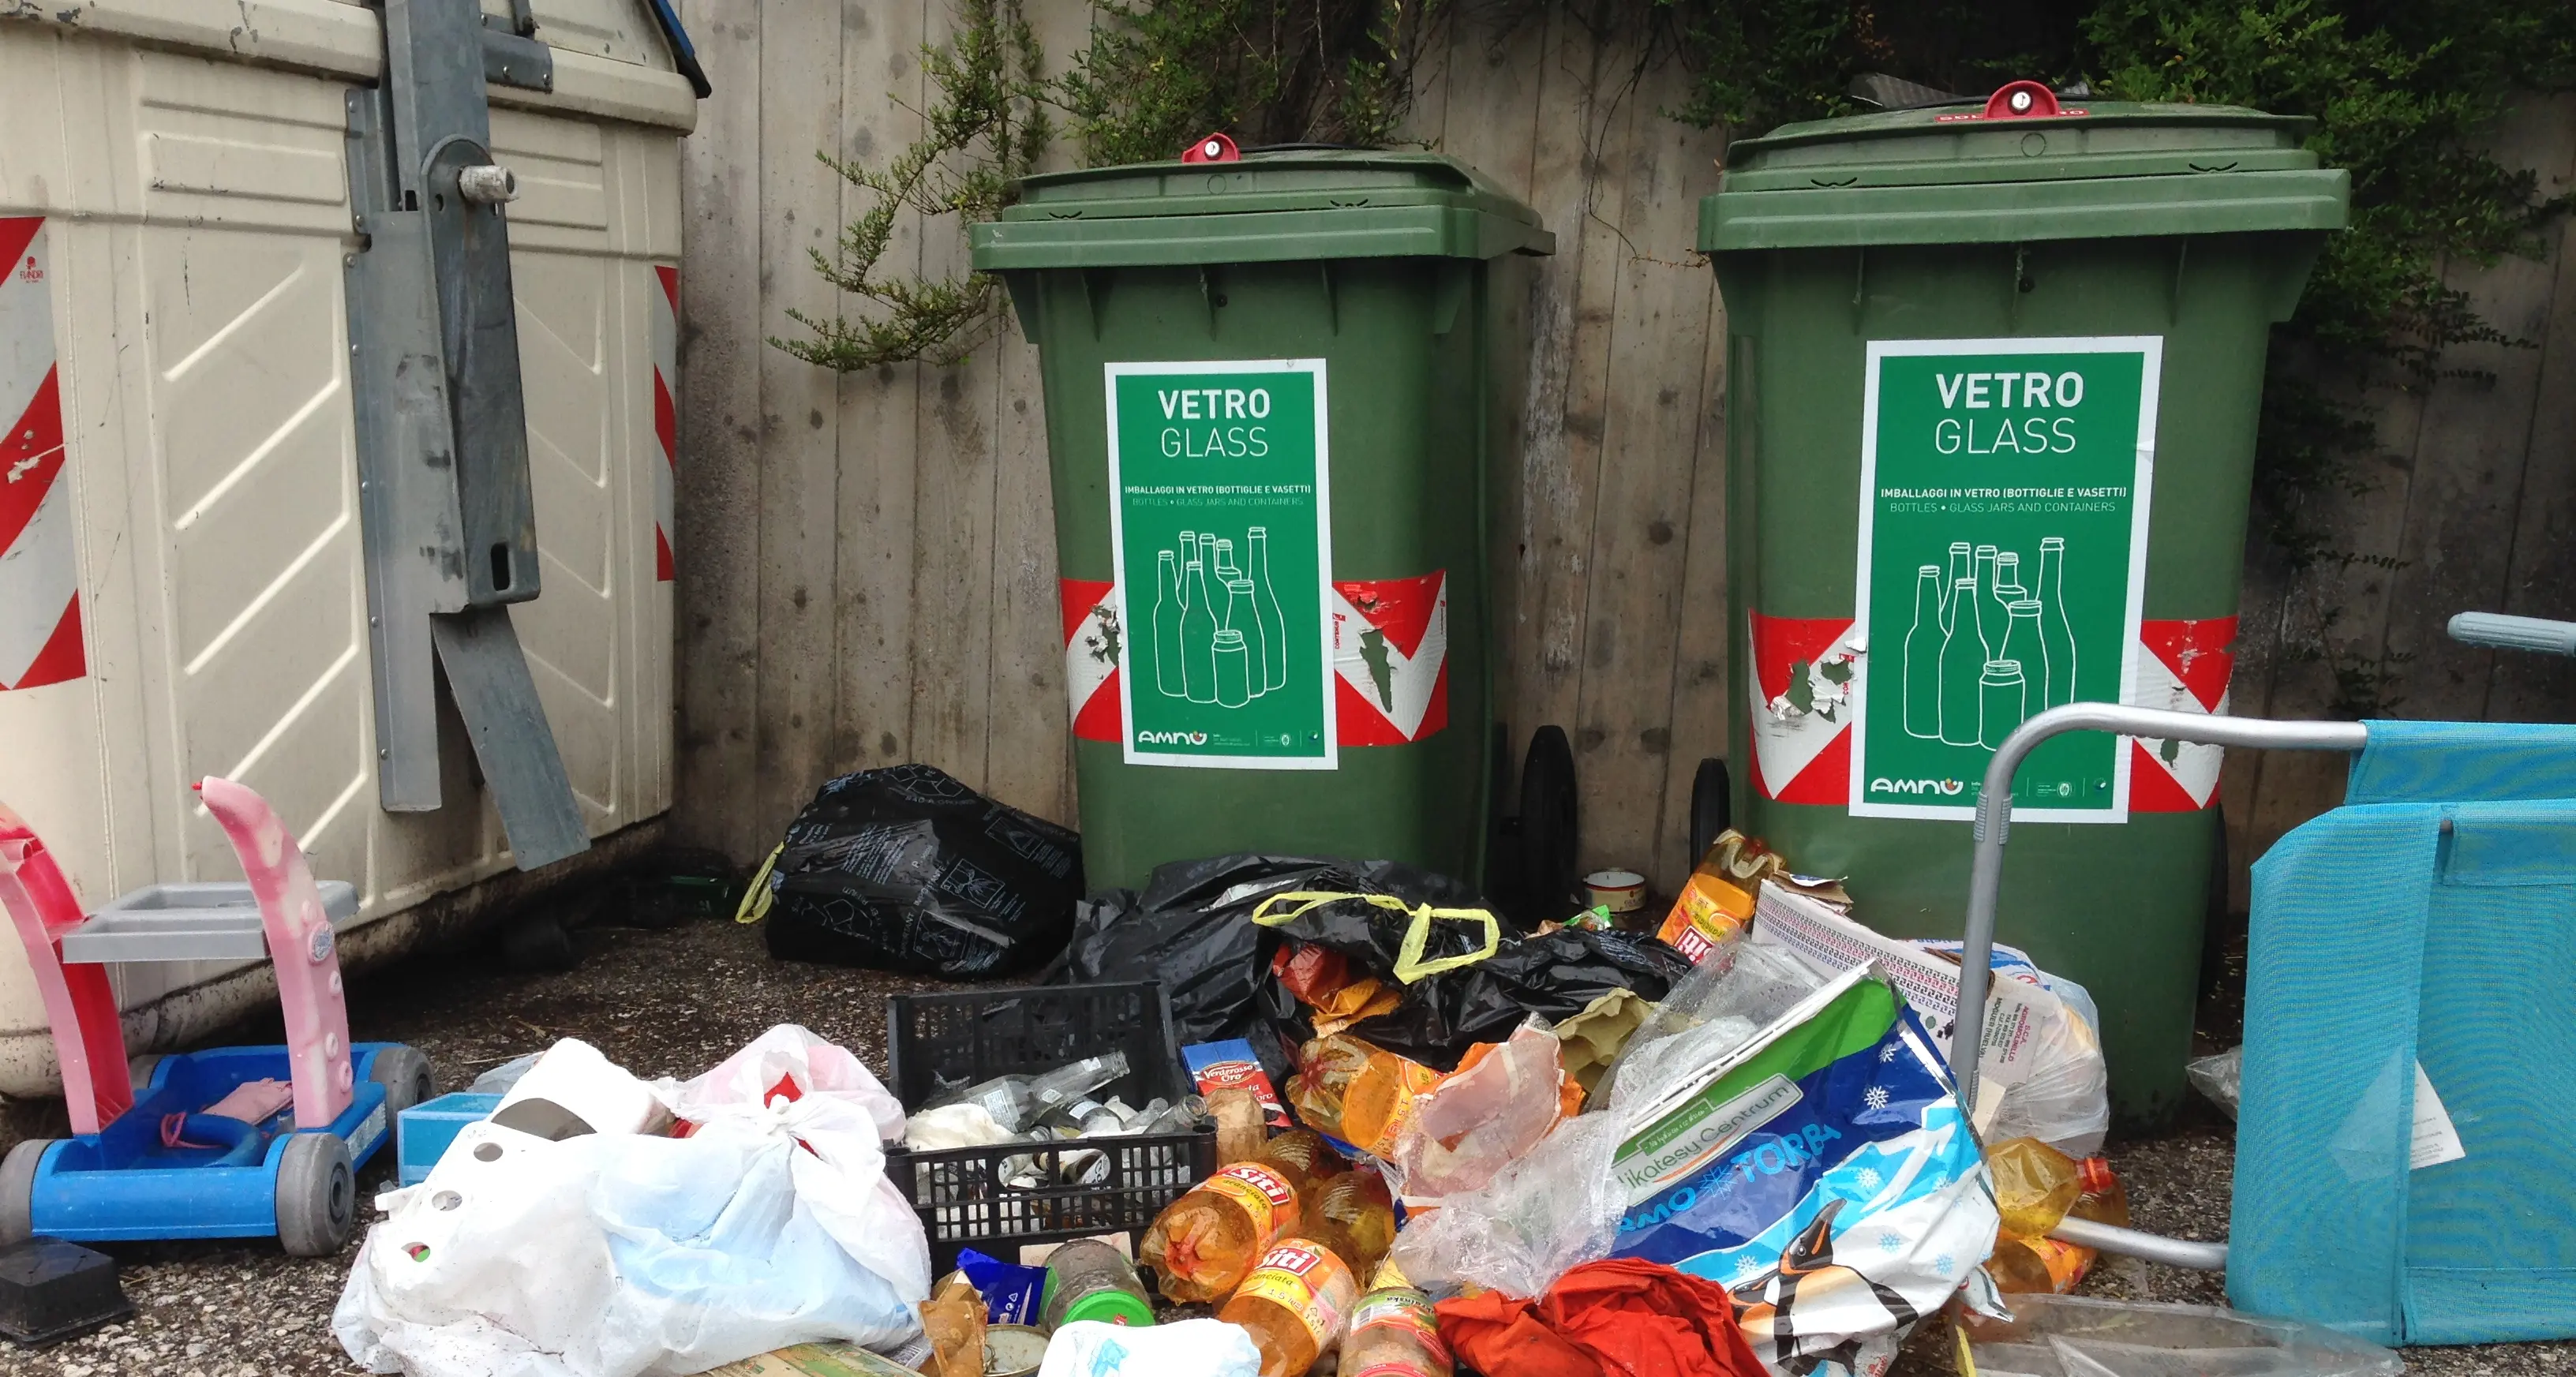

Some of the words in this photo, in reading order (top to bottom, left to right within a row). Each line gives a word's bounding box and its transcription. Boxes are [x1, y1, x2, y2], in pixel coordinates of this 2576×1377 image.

[1157, 387, 1271, 420] VETRO
[1935, 371, 2084, 410] VETRO
[1160, 426, 1269, 458] GLASS
[1934, 417, 2077, 455] GLASS
[1125, 485, 1174, 495] IMBALLAGGI
[1175, 485, 1185, 494] IN
[1186, 485, 1215, 494] VETRO
[1215, 484, 1263, 495] (BOTTIGLIE
[1265, 484, 1271, 494] E
[1271, 484, 1311, 494] VASETTI)
[1133, 498, 1169, 507] BOTTLES
[1176, 498, 1203, 507] GLASS
[1204, 498, 1227, 507] JARS
[1228, 498, 1247, 507] AND
[1248, 497, 1304, 507] CONTAINERS
[1881, 488, 1948, 499] IMBALLAGGI
[1950, 488, 1962, 498] IN
[1964, 488, 2001, 498] VETRO
[2002, 487, 2065, 499] (BOTTIGLIE
[2067, 487, 2074, 497] E
[2076, 486, 2127, 498] VASETTI)
[1890, 503, 1938, 513] BOTTLES
[1949, 503, 1985, 513] GLASS
[1986, 503, 2015, 513] JARS
[2016, 503, 2042, 513] AND
[2044, 502, 2116, 513] CONTAINERS
[1988, 997, 2003, 1027] MOGUER
[1221, 1072, 1245, 1082] Oro
[1699, 1084, 1789, 1143] Centrum
[1230, 1166, 1285, 1198] Siti
[1616, 1186, 1697, 1237] RMO
[1730, 1122, 1843, 1184] TORBA
